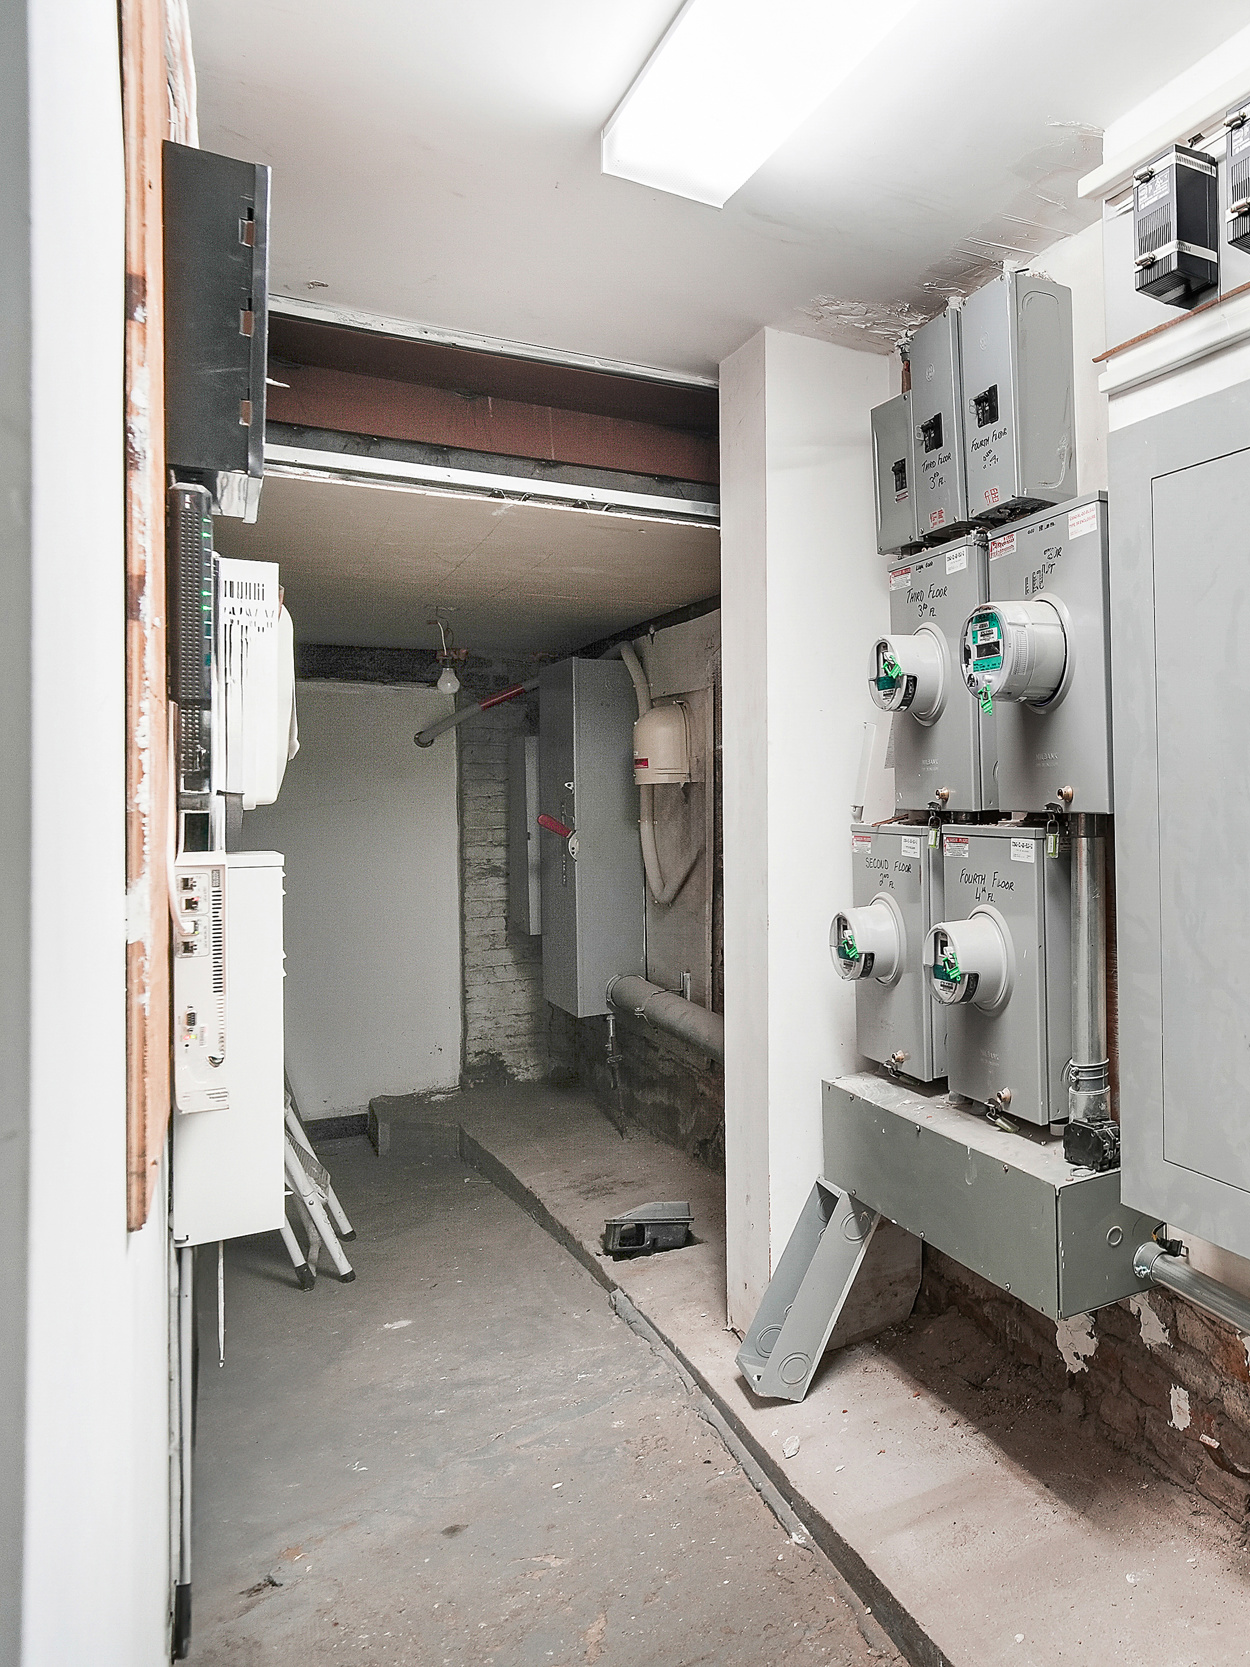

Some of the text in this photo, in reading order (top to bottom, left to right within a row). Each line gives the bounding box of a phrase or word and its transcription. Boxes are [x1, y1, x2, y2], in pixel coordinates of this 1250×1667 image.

[991, 427, 1008, 442] FLOOR
[922, 452, 952, 473] THIRD FLOOR
[907, 583, 948, 603] THIRD FLOOR
[865, 857, 912, 873] SECOND FLOOR
[959, 867, 1015, 891] FOURTH FLOOR
